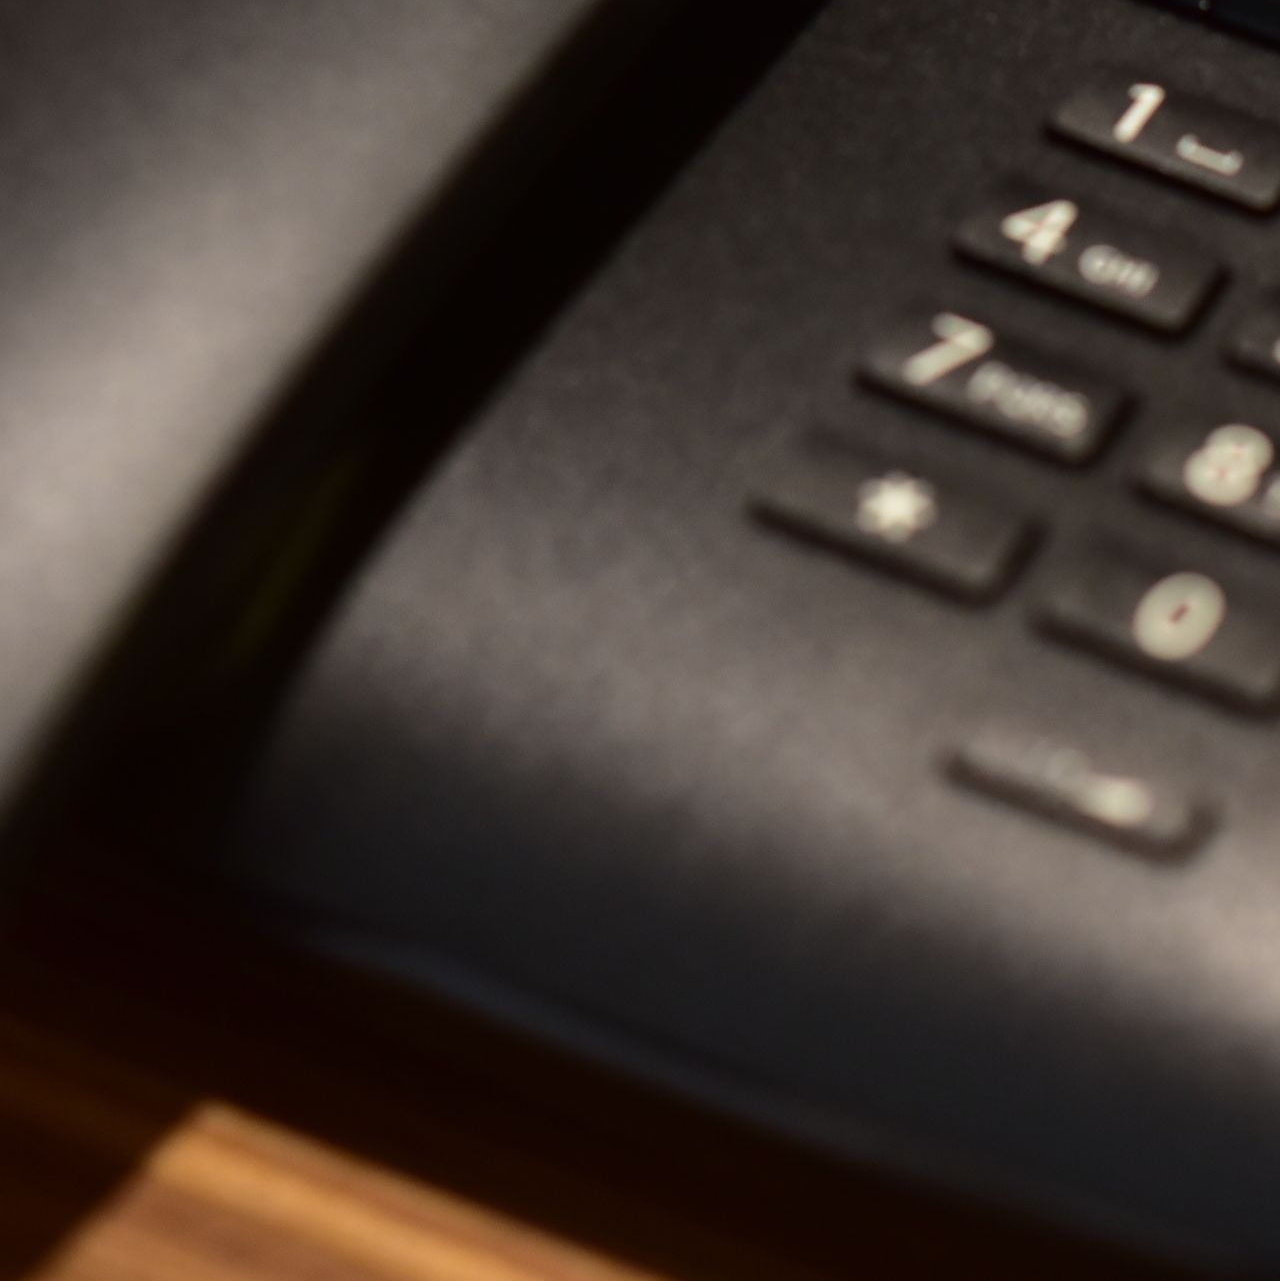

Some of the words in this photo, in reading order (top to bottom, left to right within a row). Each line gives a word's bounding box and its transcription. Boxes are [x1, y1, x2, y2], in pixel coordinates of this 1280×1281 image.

[1112, 82, 1166, 144] 1
[1001, 199, 1079, 266] 4
[901, 313, 994, 386] 7
[1183, 424, 1275, 507] 8
[1131, 571, 1227, 662] 0
